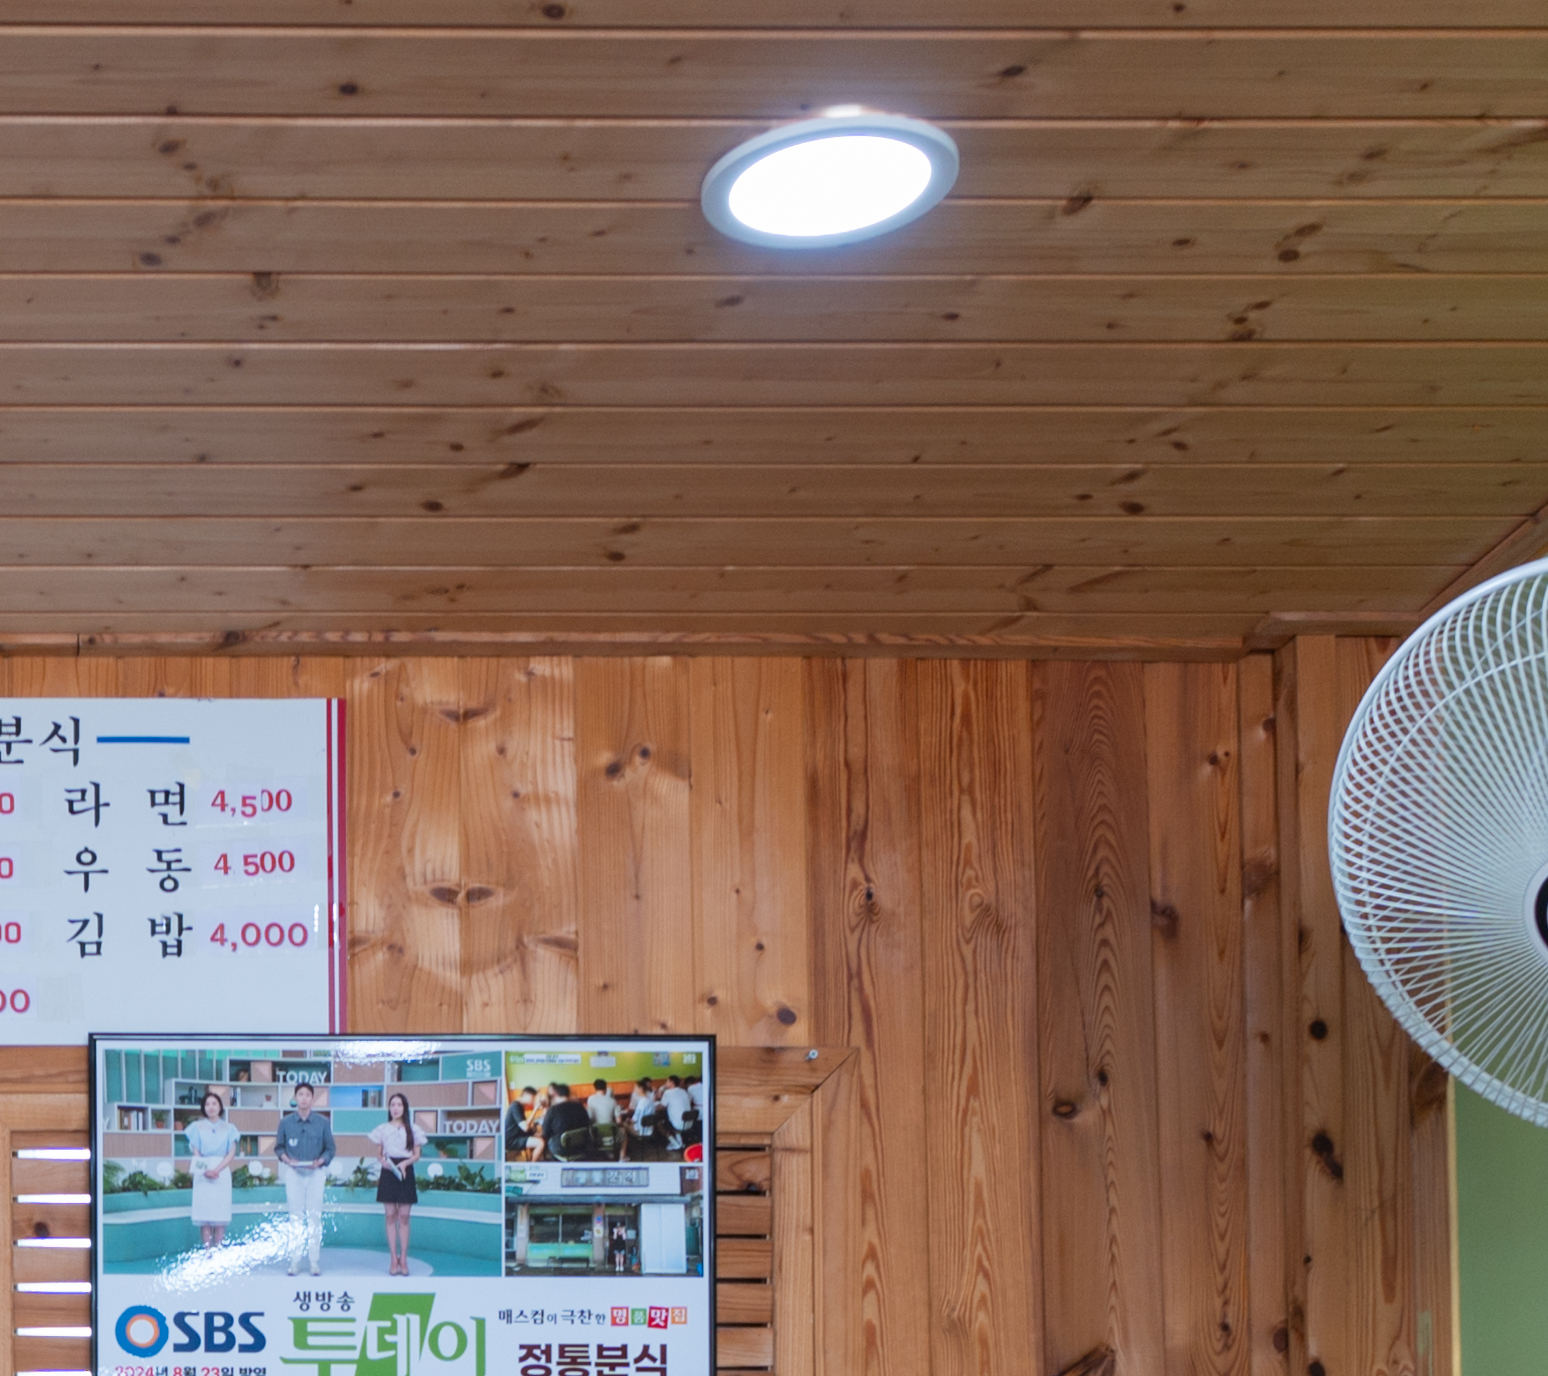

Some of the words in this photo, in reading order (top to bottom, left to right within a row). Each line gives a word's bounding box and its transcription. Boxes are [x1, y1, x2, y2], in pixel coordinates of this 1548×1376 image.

[213, 850, 295, 877] 4500
[209, 922, 308, 951] 4,000
[466, 1058, 491, 1072] SBS
[276, 1070, 327, 1084] TODAY
[444, 1119, 500, 1135] TODAY
[293, 1291, 355, 1312] 생방송
[172, 1311, 267, 1353] SBS
